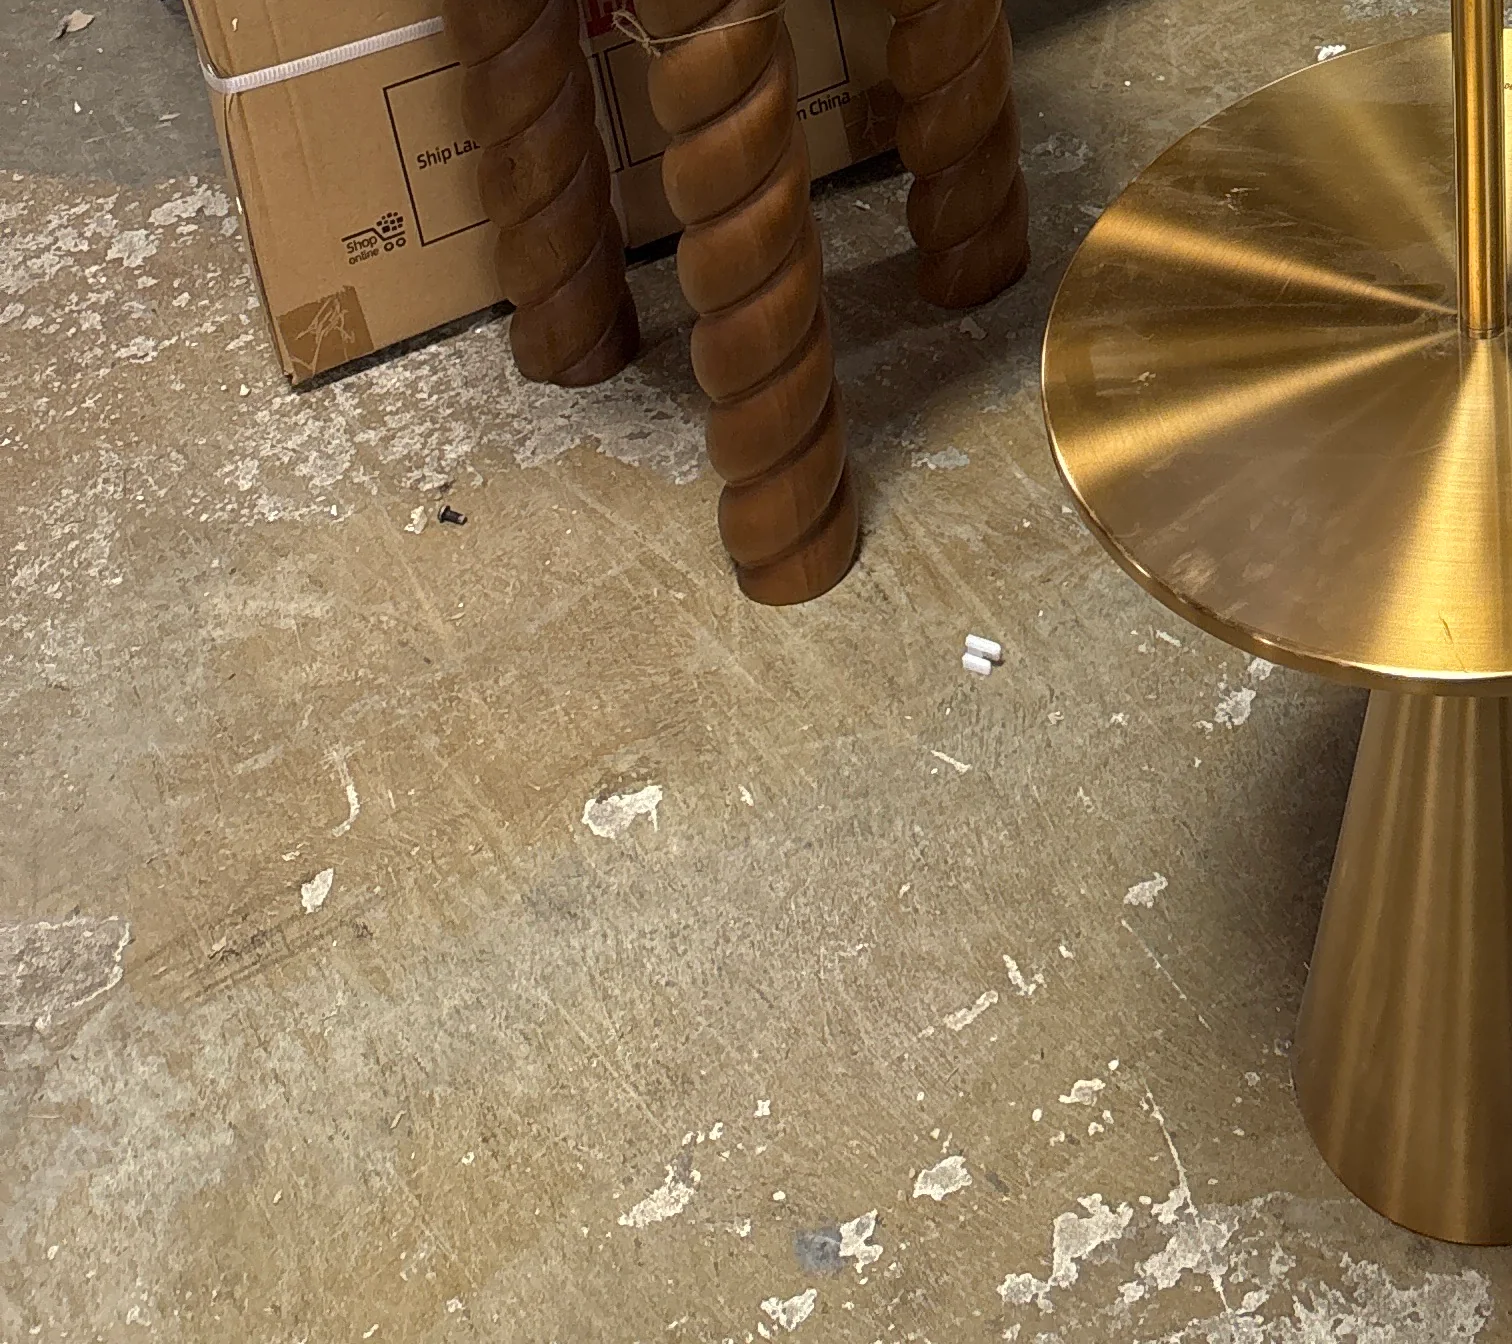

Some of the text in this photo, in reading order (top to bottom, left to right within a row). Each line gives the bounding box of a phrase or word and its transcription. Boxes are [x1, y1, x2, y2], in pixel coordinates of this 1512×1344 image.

[809, 92, 851, 116] China
[417, 146, 452, 170] Ship
[346, 235, 378, 254] Shop
[348, 247, 380, 265] online
